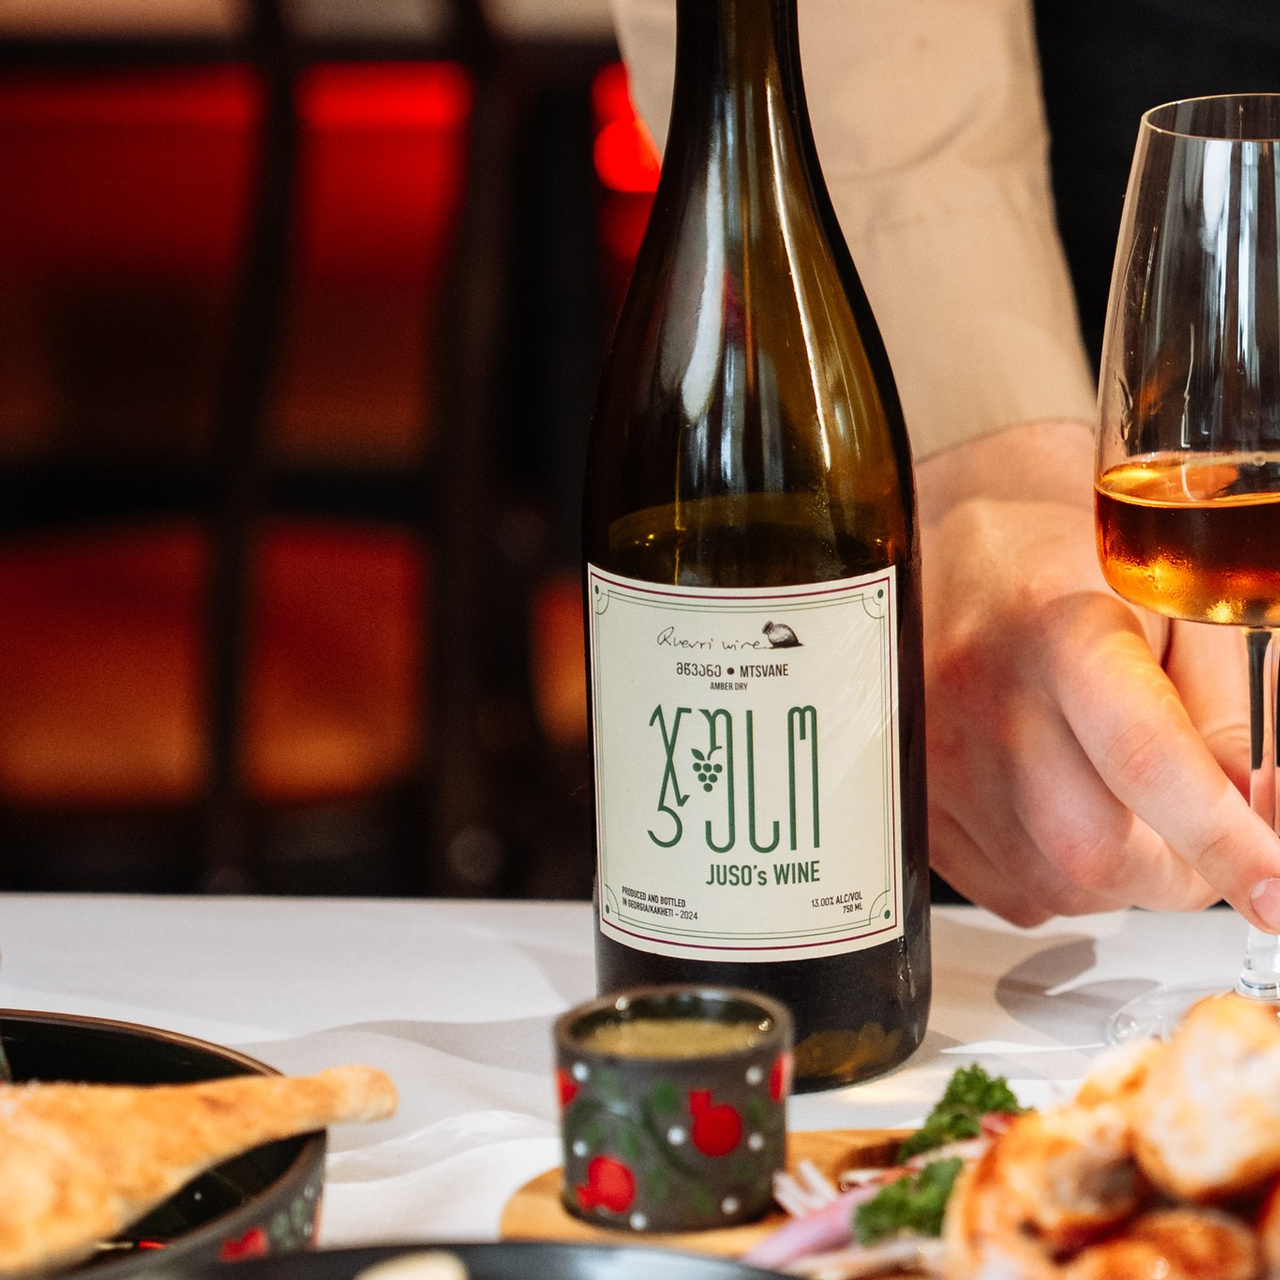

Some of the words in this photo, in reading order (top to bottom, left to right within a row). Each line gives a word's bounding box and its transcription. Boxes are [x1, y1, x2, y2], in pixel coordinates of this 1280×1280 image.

[721, 638, 764, 651] wine
[676, 661, 722, 677] მწვანე
[739, 663, 789, 678] MTSVANE
[710, 682, 733, 691] AMBER
[735, 682, 748, 691] DRY
[773, 860, 820, 885] WINE
[622, 886, 647, 901] PRODUCED
[647, 894, 659, 904] AND
[660, 896, 686, 907] BOTTLED
[835, 891, 862, 904] ALC/VOL
[622, 897, 627, 906] IN
[628, 899, 673, 917] GEORGIA/KAKHETI
[680, 910, 698, 920] 2024
[843, 904, 853, 914] 750
[855, 902, 862, 911] ML
